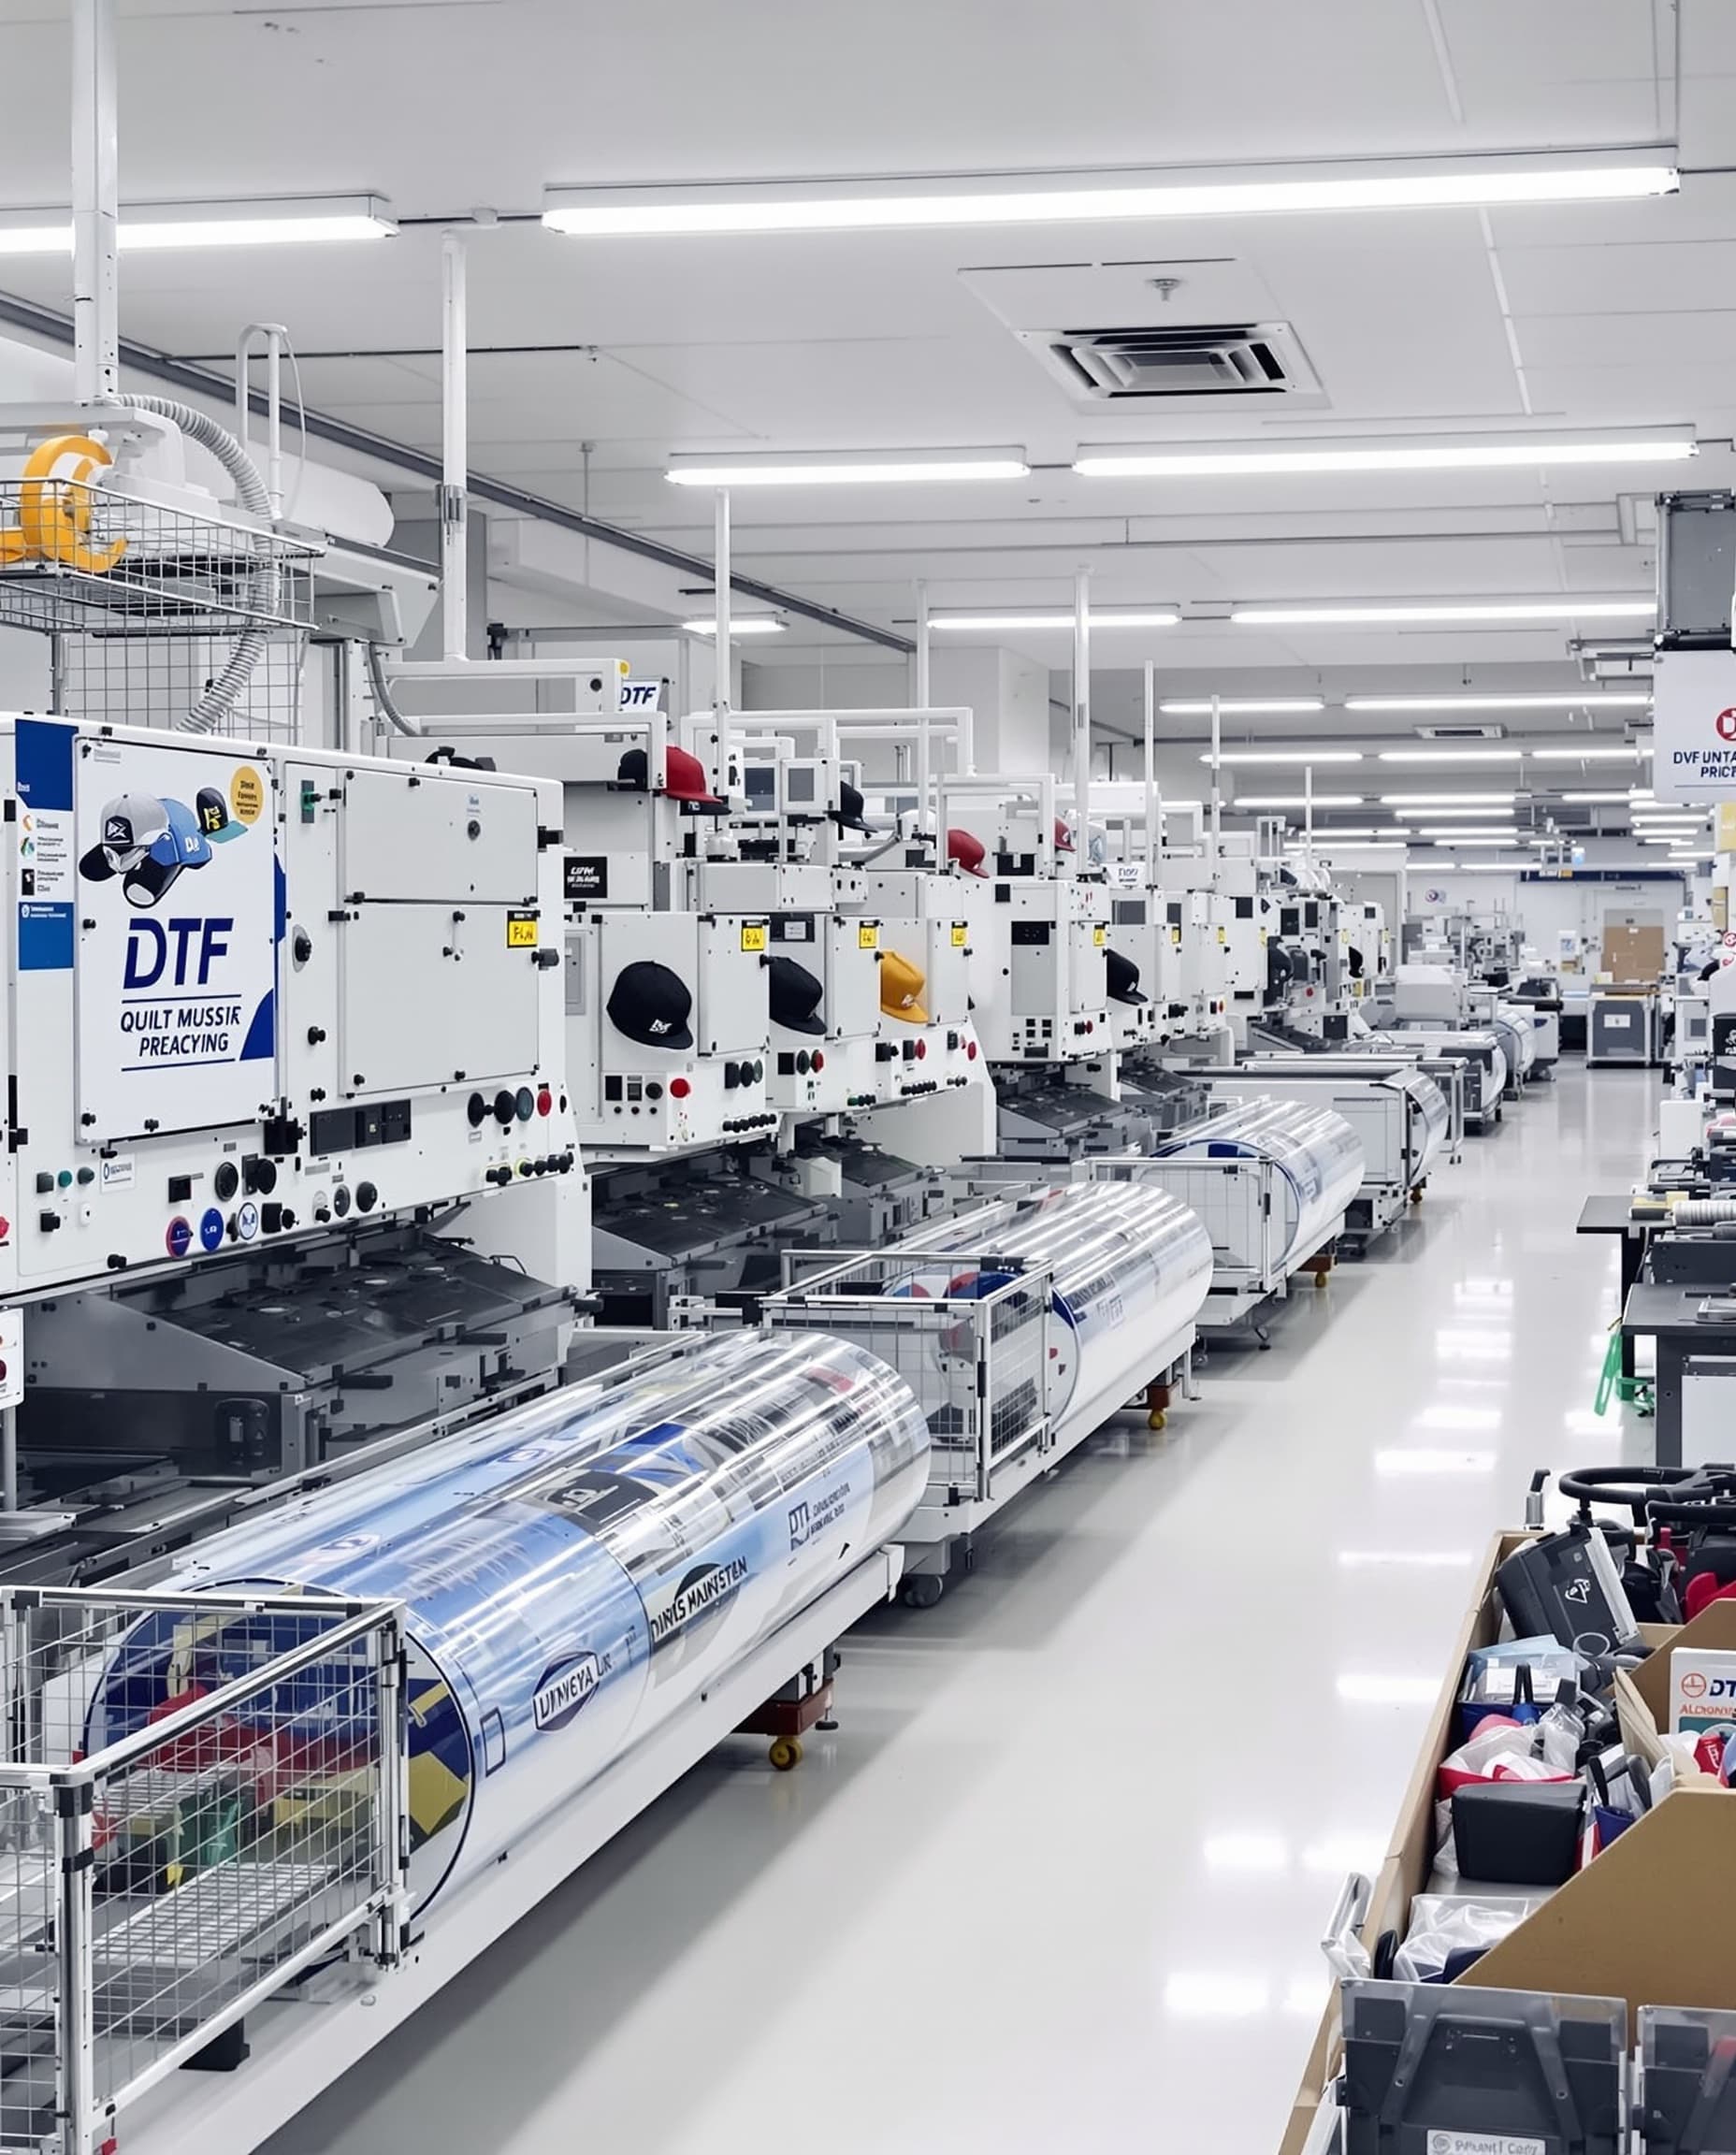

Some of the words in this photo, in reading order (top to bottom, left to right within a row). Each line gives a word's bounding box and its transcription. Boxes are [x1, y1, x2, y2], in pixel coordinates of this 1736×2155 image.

[621, 687, 657, 704] DTF
[1673, 751, 1700, 764] DVF
[123, 918, 234, 990] DTF
[121, 1009, 172, 1033] QUILT
[139, 1033, 229, 1057] PREACYING
